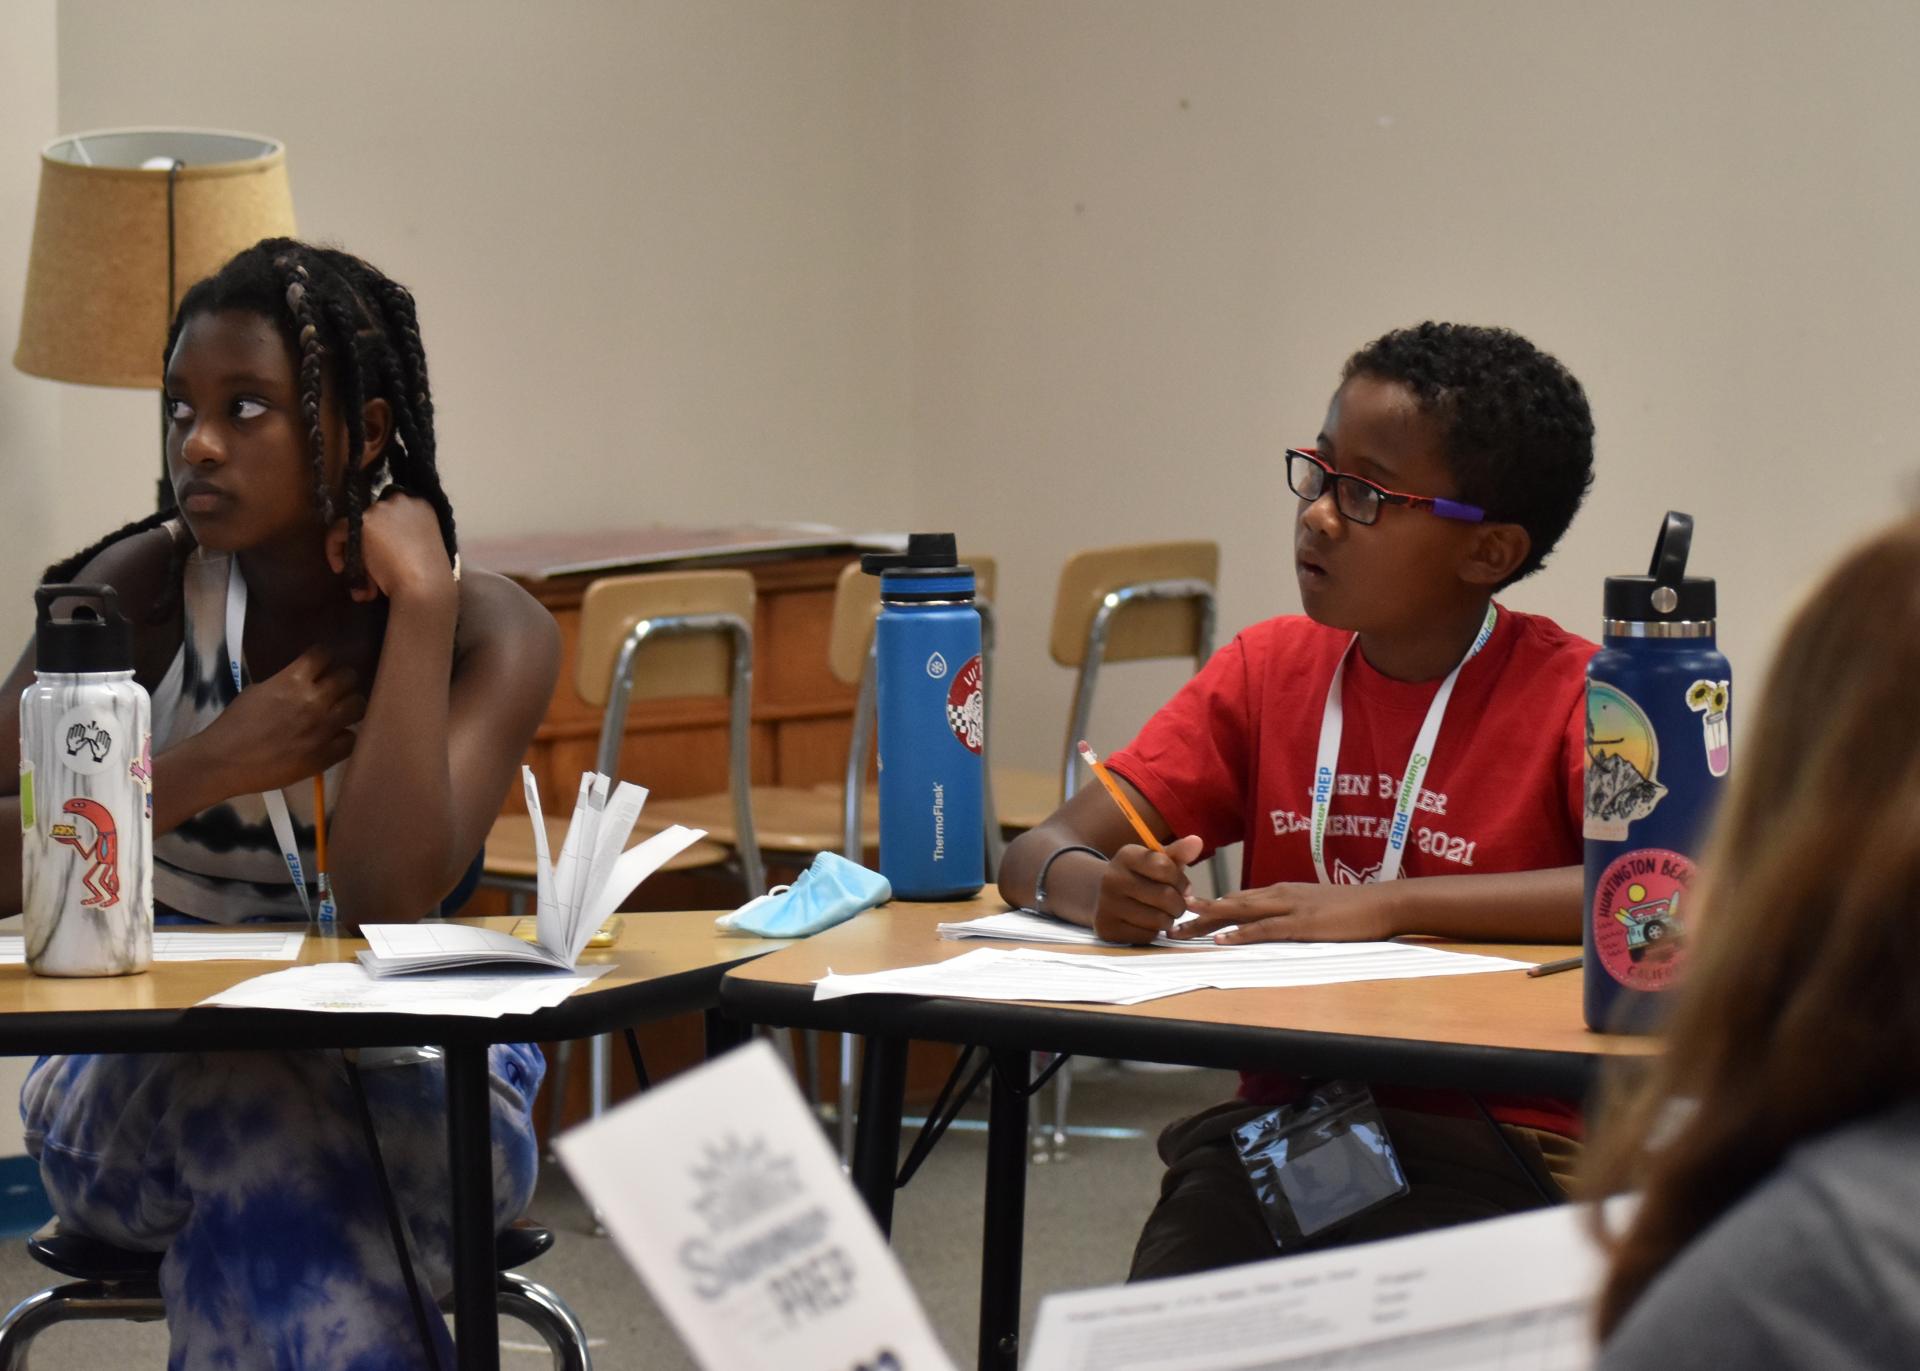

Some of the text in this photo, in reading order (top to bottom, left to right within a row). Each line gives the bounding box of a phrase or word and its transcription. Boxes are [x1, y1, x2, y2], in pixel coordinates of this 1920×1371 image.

[1316, 767, 1332, 802] PREP
[933, 782, 945, 861] ThermoFlask
[1391, 812, 1409, 850] PREP
[1417, 827, 1476, 866] 2021
[1599, 858, 1656, 917] HUNTINGTON
